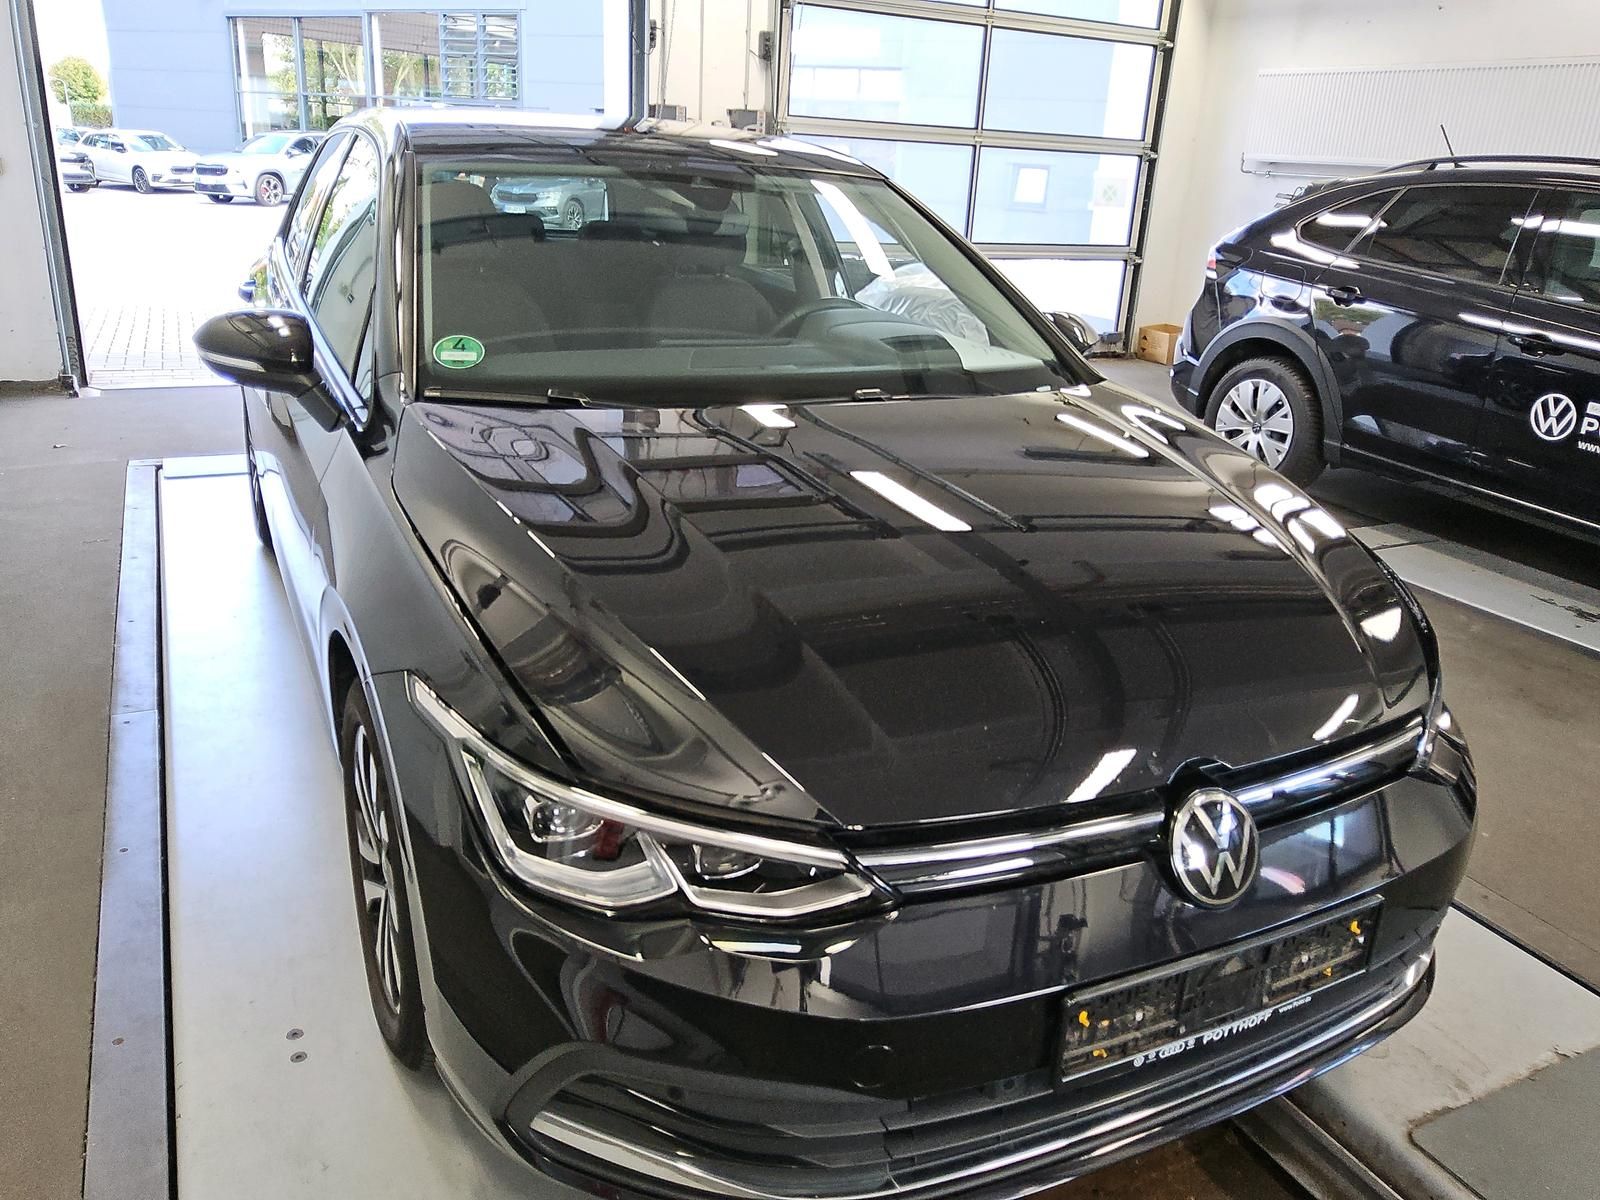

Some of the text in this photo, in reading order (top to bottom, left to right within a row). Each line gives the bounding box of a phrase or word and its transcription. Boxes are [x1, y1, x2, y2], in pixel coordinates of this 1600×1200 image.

[452, 337, 466, 352] 4
[1533, 394, 1576, 439] VW
[1579, 416, 1600, 435] P
[1175, 793, 1255, 903] VW
[1203, 1007, 1273, 1046] POTTHOFF
